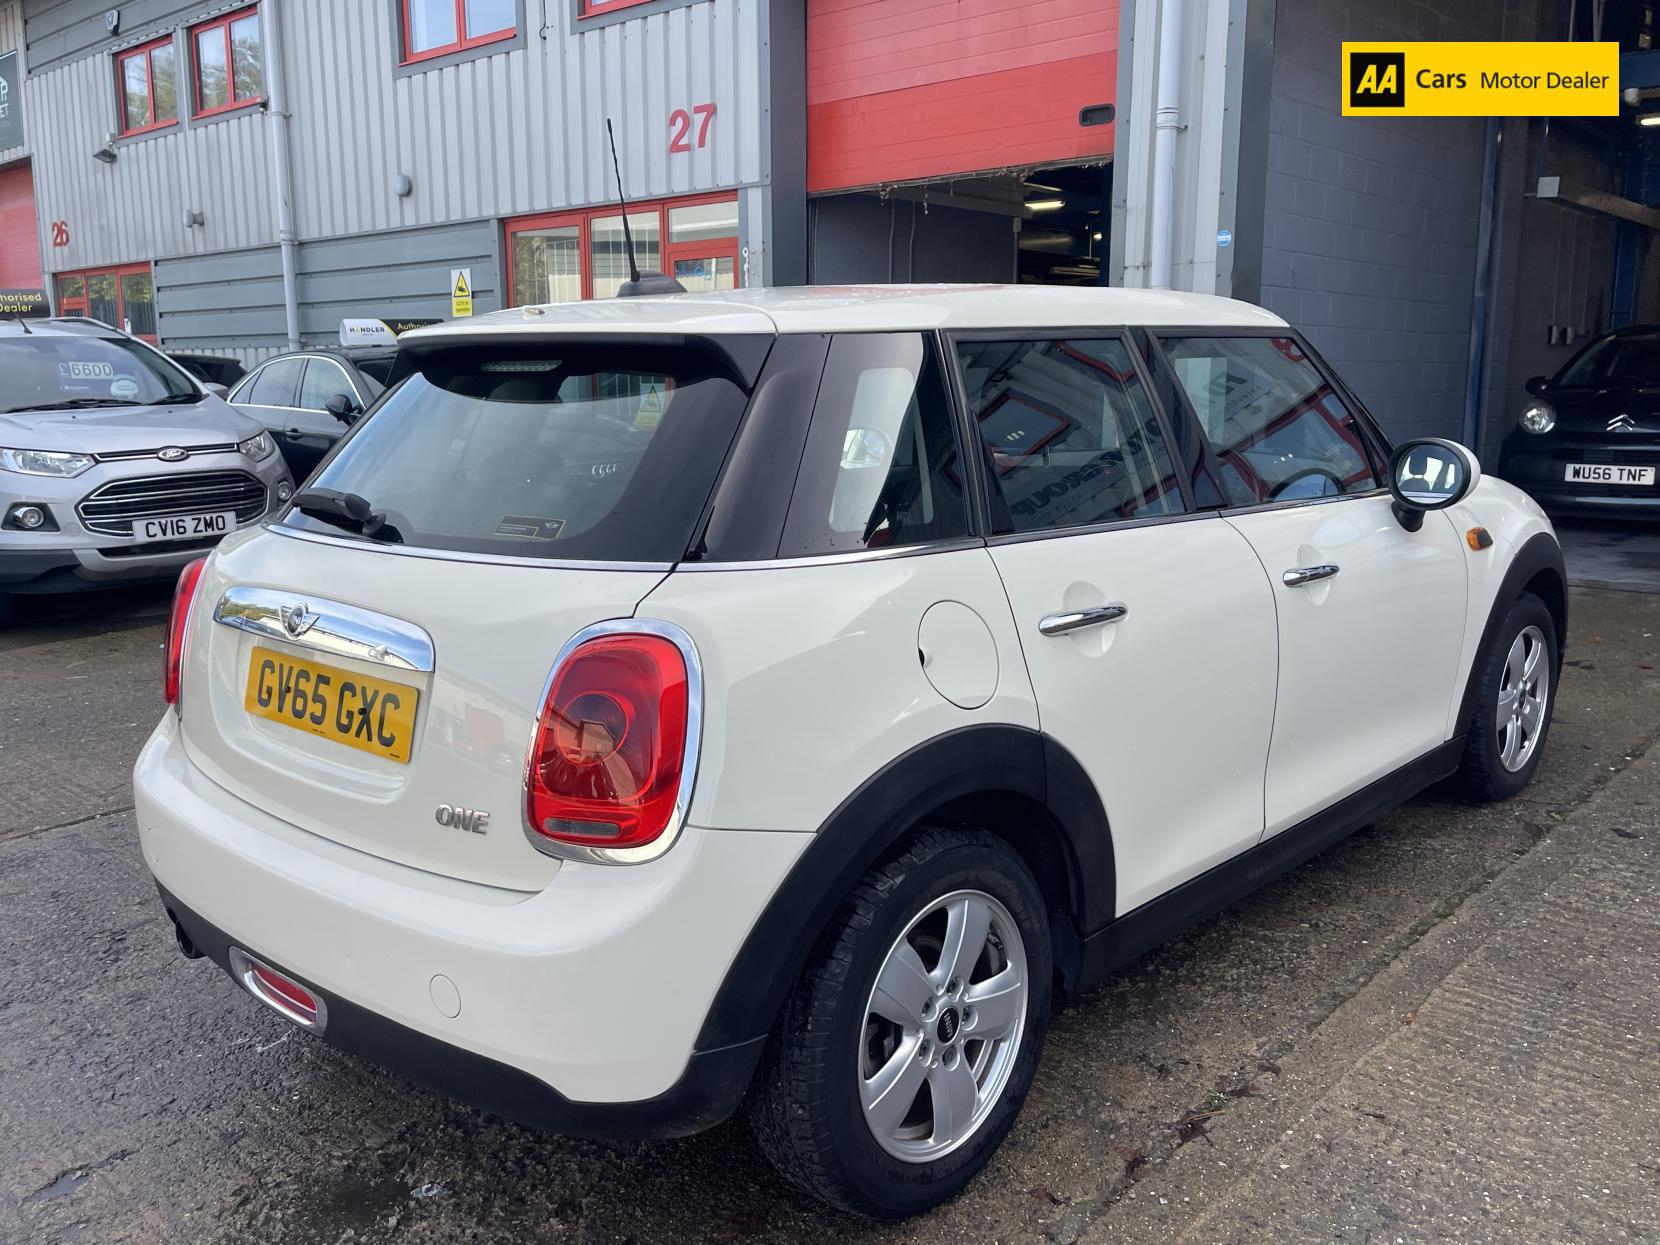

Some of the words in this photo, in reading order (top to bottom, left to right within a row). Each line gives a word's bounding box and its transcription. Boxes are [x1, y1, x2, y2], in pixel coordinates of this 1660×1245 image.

[669, 103, 715, 154] 27
[52, 220, 70, 247] 26
[1572, 465, 1612, 481] WU56
[1617, 468, 1649, 482] TNF
[145, 518, 187, 538] CV16
[191, 515, 226, 533] ZMO
[257, 659, 331, 726] GV65
[335, 681, 401, 748] GXC
[436, 803, 490, 835] ONE
